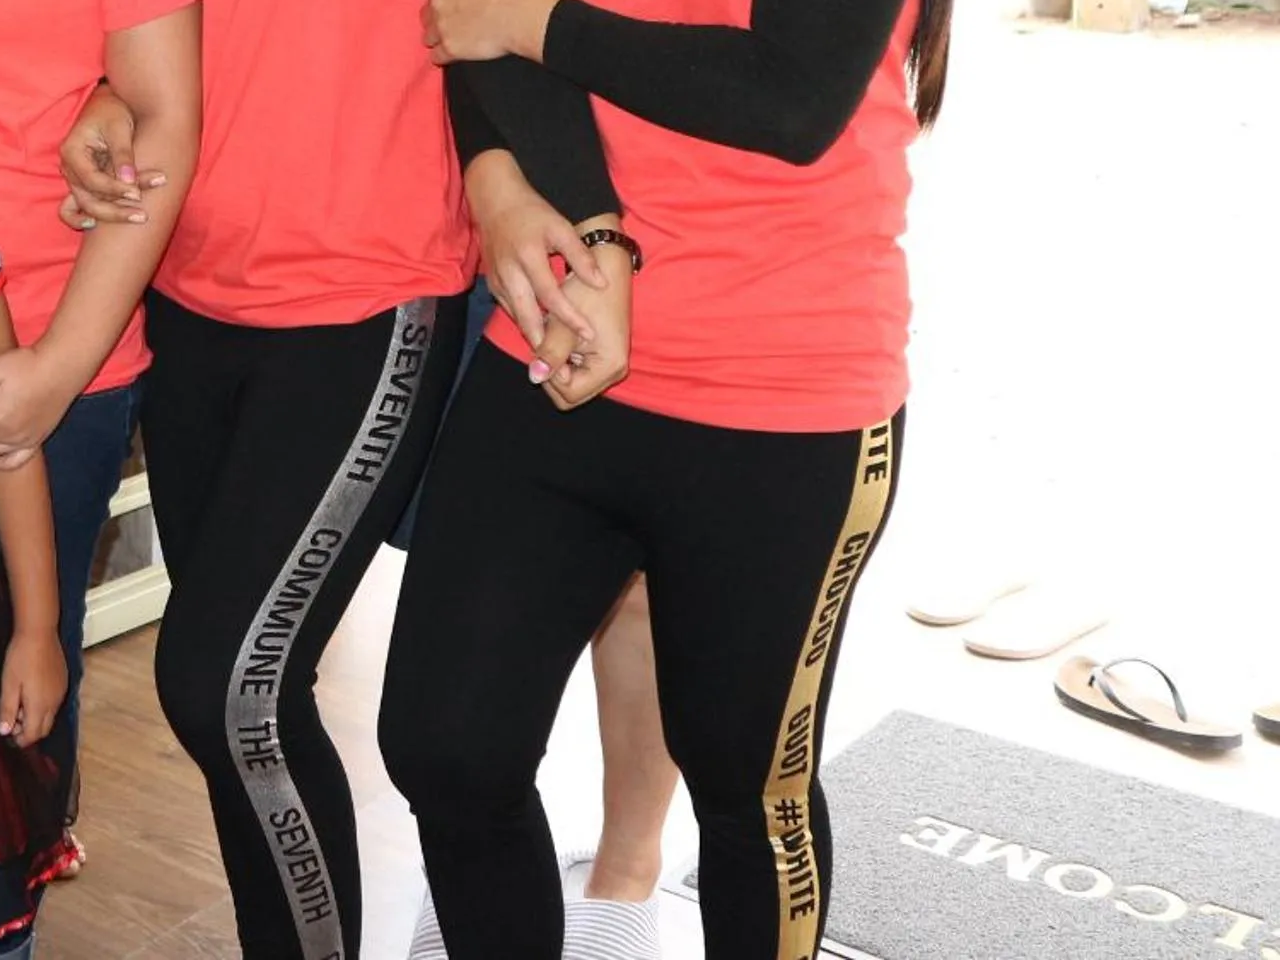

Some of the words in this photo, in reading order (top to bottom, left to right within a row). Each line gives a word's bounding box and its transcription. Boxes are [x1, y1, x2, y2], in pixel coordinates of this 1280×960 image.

[346, 323, 428, 483] SEVENTH
[240, 528, 342, 696] COMMUNE
[238, 720, 279, 771] THE
[270, 807, 332, 924] SEVENTH
